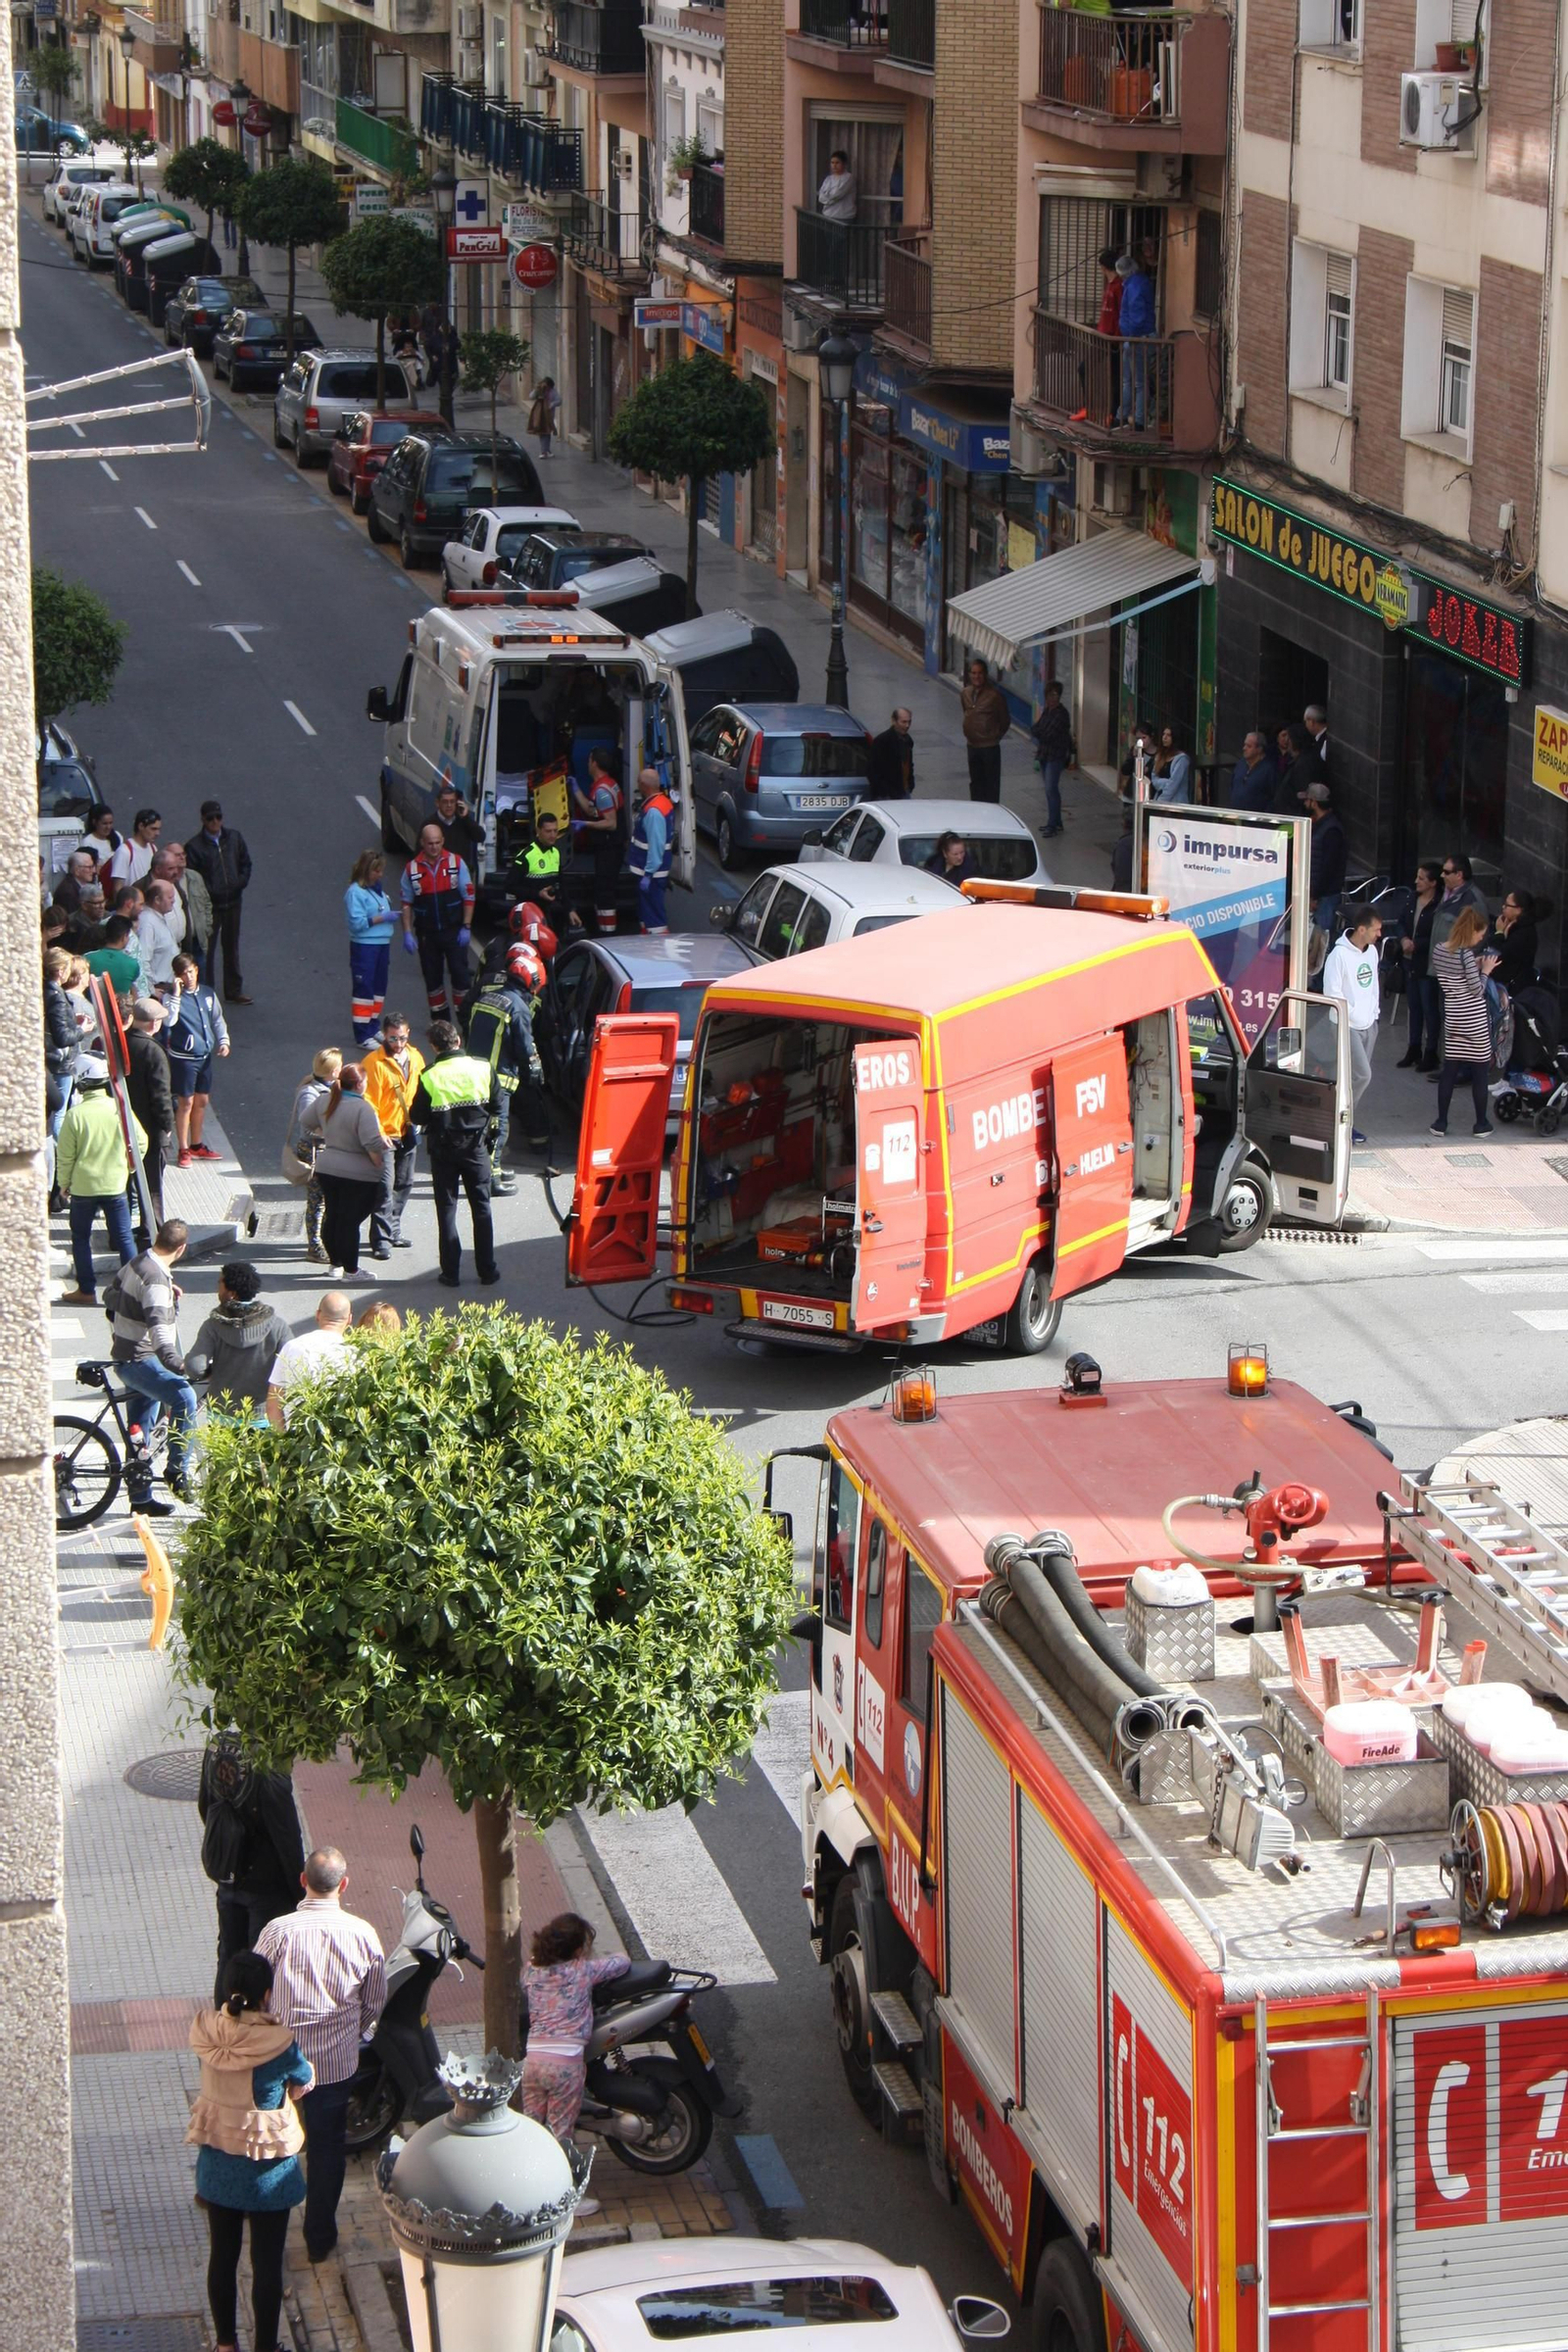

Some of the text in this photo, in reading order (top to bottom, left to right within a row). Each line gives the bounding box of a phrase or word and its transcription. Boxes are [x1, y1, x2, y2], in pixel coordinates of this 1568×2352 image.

[983, 437, 1009, 451] Baz
[1214, 485, 1376, 604] SALON de JUEGO
[1427, 588, 1520, 678] JOKER
[1539, 715, 1568, 755] ZAP
[1538, 748, 1568, 776] REPARAC
[802, 797, 848, 808] 2835 DJB
[1184, 835, 1278, 864] impursa
[1183, 862, 1231, 875] exteriorplus
[1206, 893, 1276, 925] DISPONIBLE
[1240, 988, 1280, 1010] 315
[858, 1052, 910, 1092] EROS
[1075, 1073, 1106, 1118] FSV
[889, 1134, 910, 1153] 112
[1079, 1143, 1115, 1176] HUELVA
[764, 1303, 832, 1325] H 7055 S
[867, 1696, 882, 1737] 112
[827, 1739, 834, 1770] 4
[1361, 1744, 1400, 1758] FireAde
[1142, 2096, 1186, 2205] 112
[952, 2099, 1013, 2237] BOMBEROS
[1144, 2158, 1187, 2237] Emergencias
